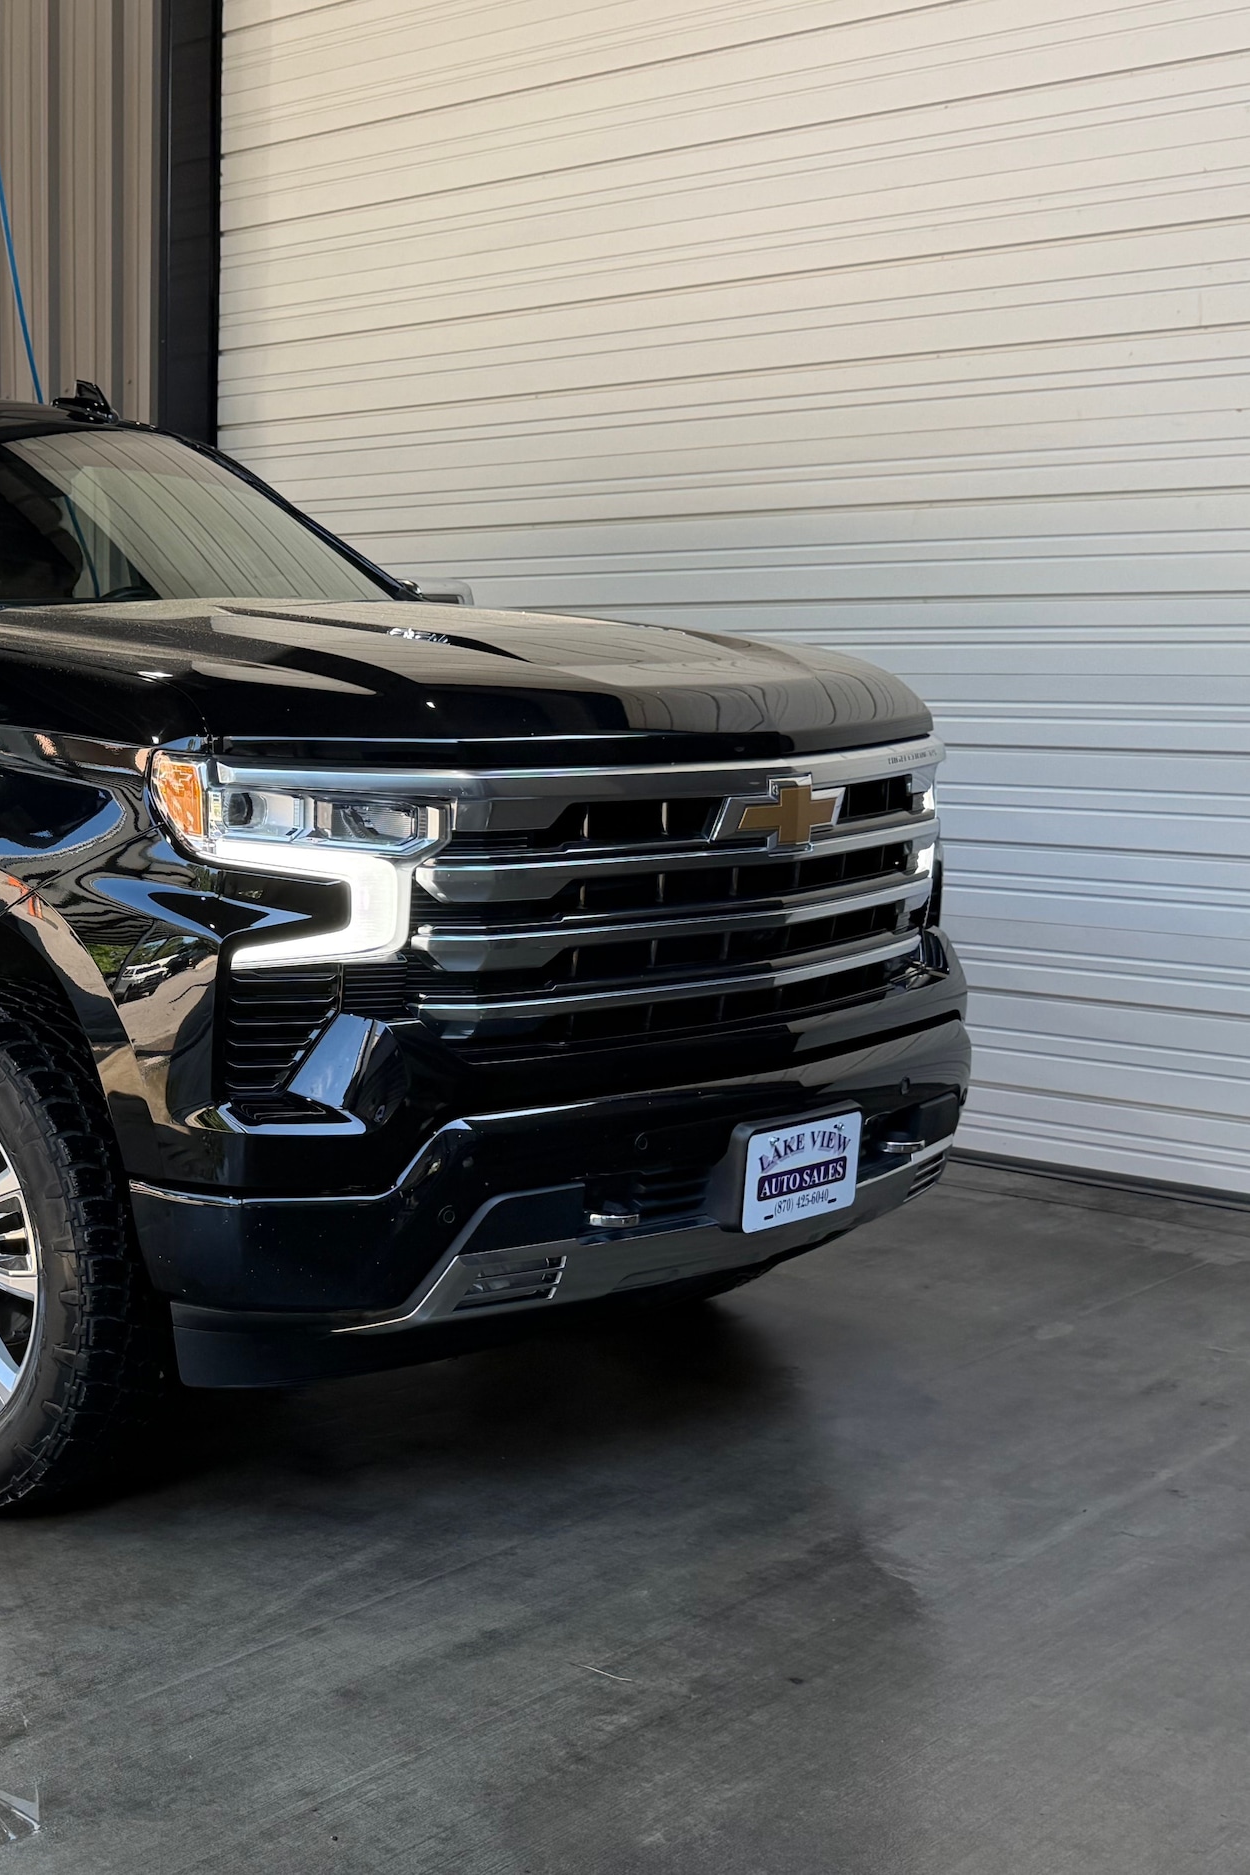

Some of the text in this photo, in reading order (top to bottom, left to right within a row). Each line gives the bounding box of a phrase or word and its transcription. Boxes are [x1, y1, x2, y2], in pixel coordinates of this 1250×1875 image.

[758, 1130, 852, 1173] LAKE VIEW
[760, 1160, 844, 1198] AUTO SALES
[774, 1198, 794, 1216] (870)
